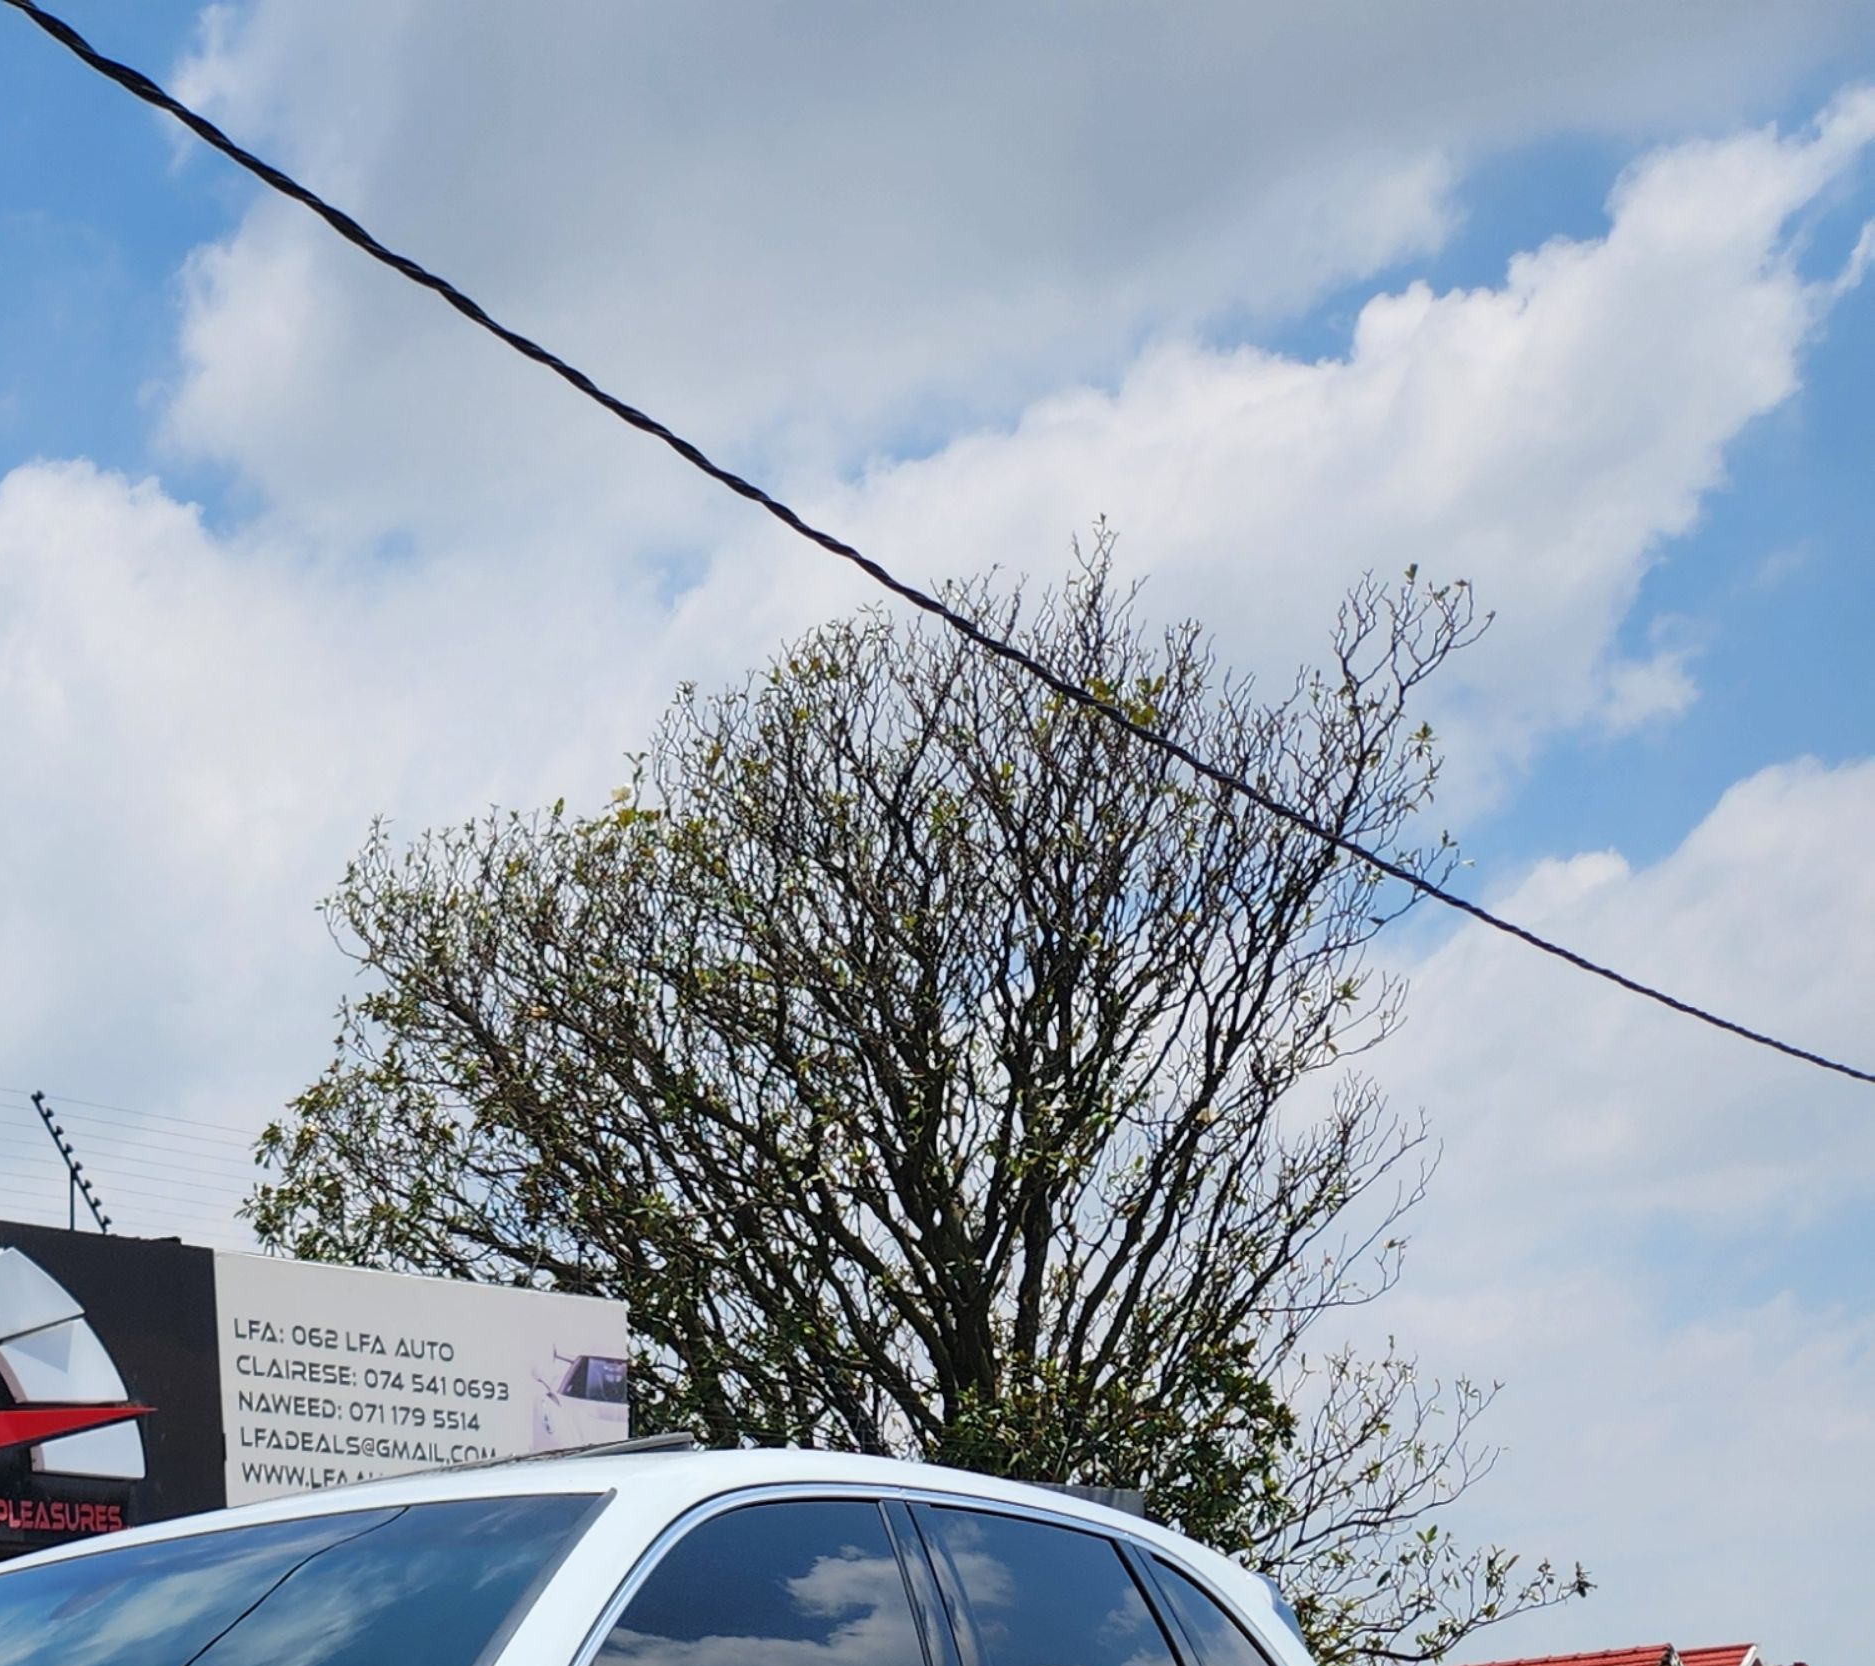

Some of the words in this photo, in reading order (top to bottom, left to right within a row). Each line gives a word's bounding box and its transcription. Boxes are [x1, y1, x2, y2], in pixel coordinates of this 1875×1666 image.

[234, 1318, 284, 1344] LFA:
[292, 1325, 338, 1350] 062
[345, 1331, 386, 1356] LFA
[395, 1337, 454, 1362] AUTO
[236, 1355, 357, 1387] CLAIRESE:
[364, 1368, 404, 1392] 074
[412, 1373, 447, 1396] 541
[453, 1378, 509, 1401] 0693
[238, 1391, 342, 1421] NAWEED:
[348, 1403, 385, 1425] 071
[392, 1406, 425, 1427] 179
[432, 1409, 480, 1432] 5514
